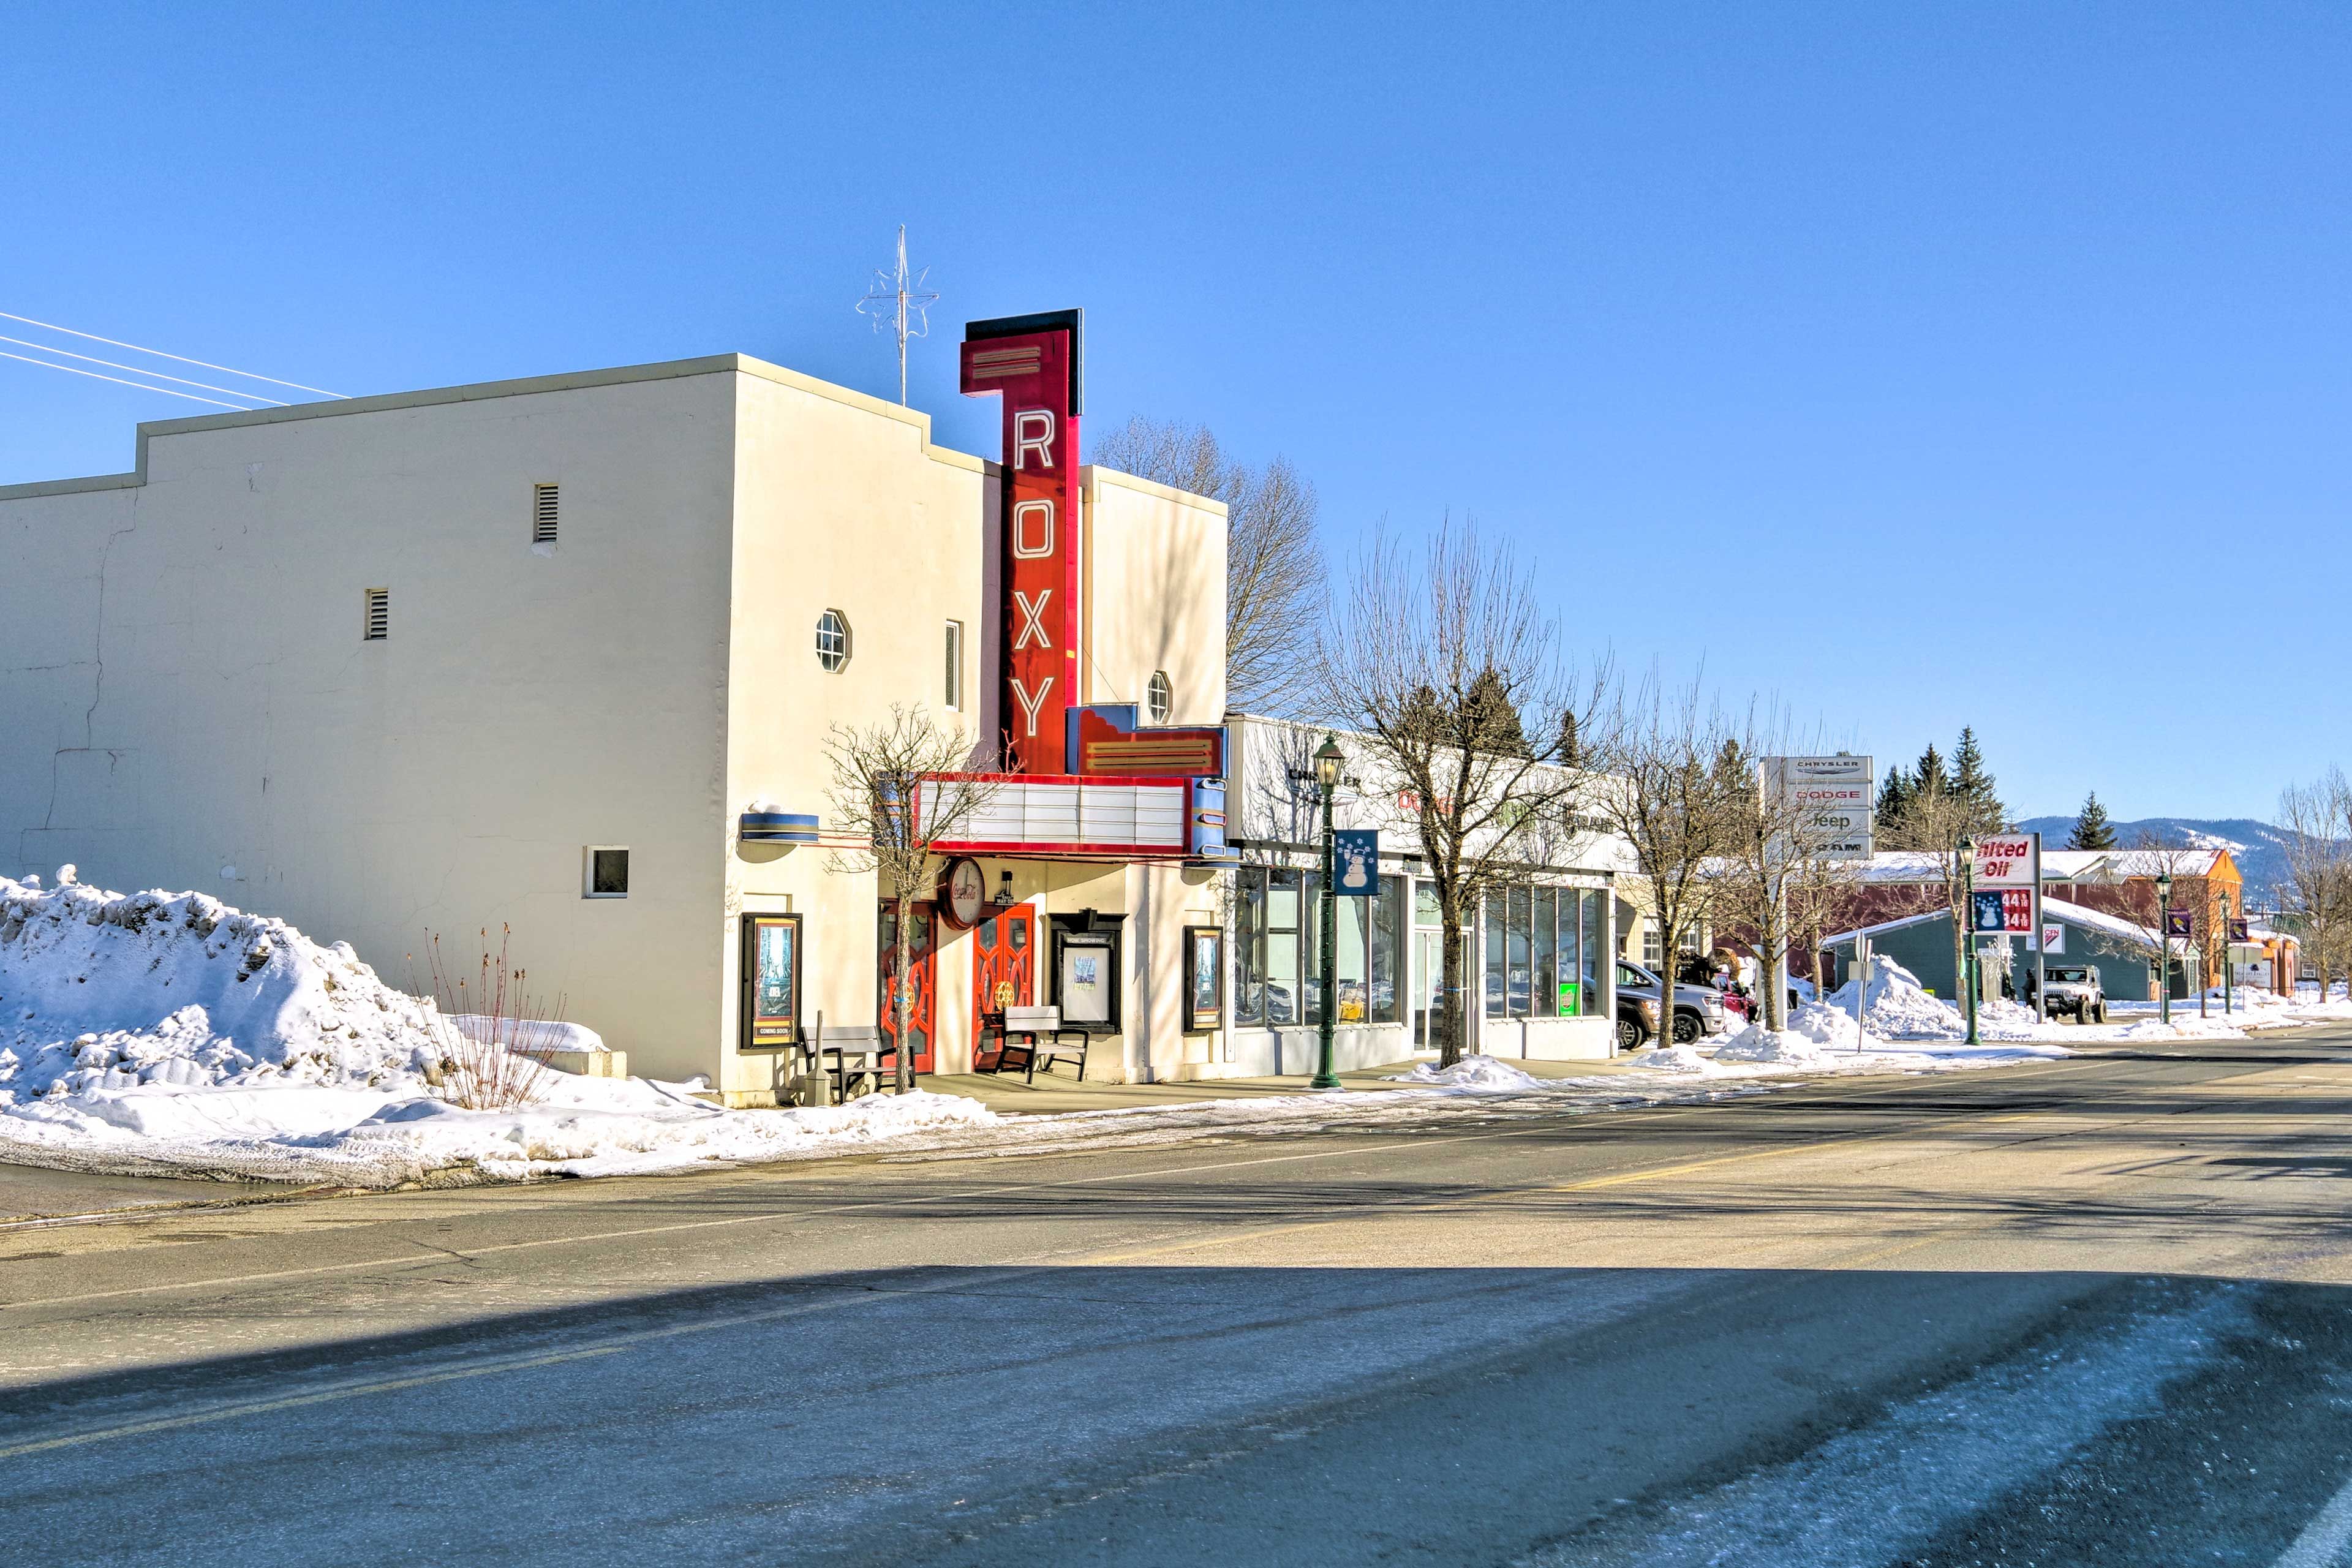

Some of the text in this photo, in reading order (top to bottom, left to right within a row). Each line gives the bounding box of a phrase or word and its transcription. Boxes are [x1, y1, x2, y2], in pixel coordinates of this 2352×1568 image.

[1010, 408, 1056, 737] ROXY
[1288, 769, 1362, 788] CHRER
[1812, 813, 1850, 830] Jeep
[1977, 840, 2029, 857] nited
